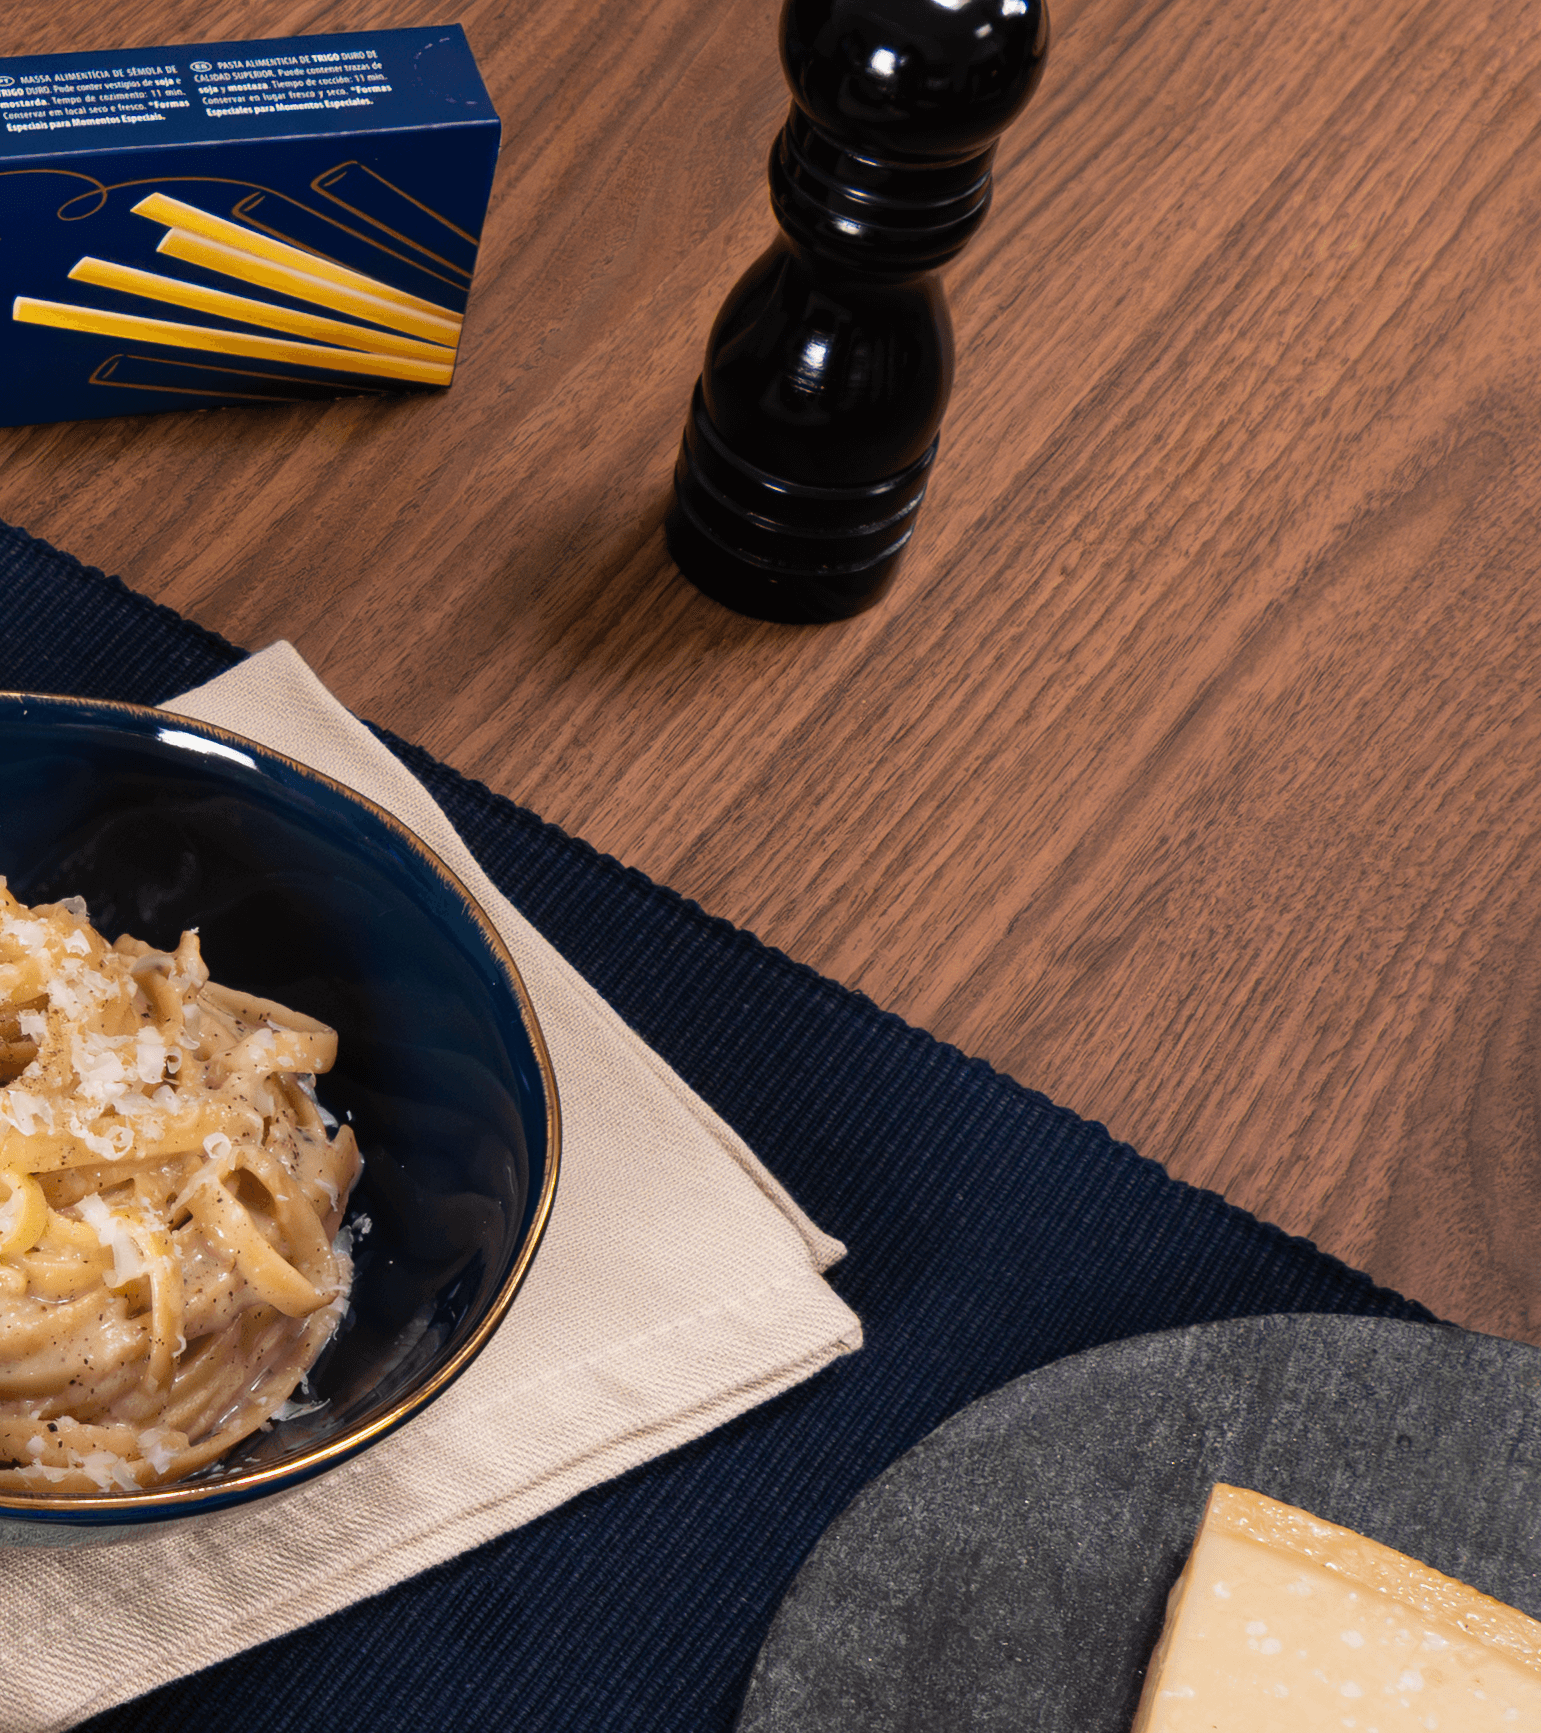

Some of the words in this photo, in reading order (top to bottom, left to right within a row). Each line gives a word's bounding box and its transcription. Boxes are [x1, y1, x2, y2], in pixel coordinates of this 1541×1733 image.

[217, 60, 244, 69] PASTA
[299, 55, 311, 63] DE
[312, 53, 340, 62] TRIGO
[341, 52, 365, 60] DURO
[366, 50, 378, 59] DE
[20, 75, 51, 84] MASSA
[55, 70, 110, 82] ALIMENTÍCIA
[113, 69, 125, 77] DE
[126, 66, 163, 77] SÉMOLA
[165, 65, 177, 74] DE
[194, 73, 231, 82] CALIDAD
[232, 70, 276, 81] SUPERIOR.
[277, 68, 305, 77] Puede
[306, 65, 343, 75] contener
[344, 63, 371, 72] trazas
[372, 62, 382, 70] de
[26, 86, 52, 95] DURO.
[53, 84, 74, 93] Pode
[76, 83, 102, 92] conter
[143, 78, 153, 87] de
[155, 77, 174, 87] soja
[176, 77, 181, 85] e
[198, 85, 219, 95] soja
[227, 83, 271, 92] mostaza.
[272, 79, 304, 90] Tiempo
[306, 78, 317, 86] de
[319, 75, 353, 85] cocción:
[355, 74, 365, 82] 11
[367, 73, 388, 81] min.
[0, 99, 50, 109] mostarda.
[52, 96, 81, 106] Tempo
[85, 93, 97, 103] de
[99, 91, 147, 102] cozimento:
[151, 89, 162, 98] 11
[165, 89, 186, 97] min.
[202, 96, 246, 105] Conservar
[249, 94, 260, 102] en
[263, 91, 286, 102] lugar
[288, 89, 316, 99] fresco
[326, 87, 349, 96] seco.
[3, 110, 46, 120] Conservar
[65, 105, 86, 115] local
[89, 105, 108, 113] seco
[118, 102, 147, 111] fresco.
[206, 105, 253, 118] Especiales
[254, 104, 275, 115] para
[276, 101, 324, 112] Momentos
[325, 97, 373, 109] Especiales.
[7, 119, 48, 133] Especiais
[49, 118, 71, 130] para
[72, 117, 121, 127] Momentos
[122, 112, 166, 124] Especiais.
